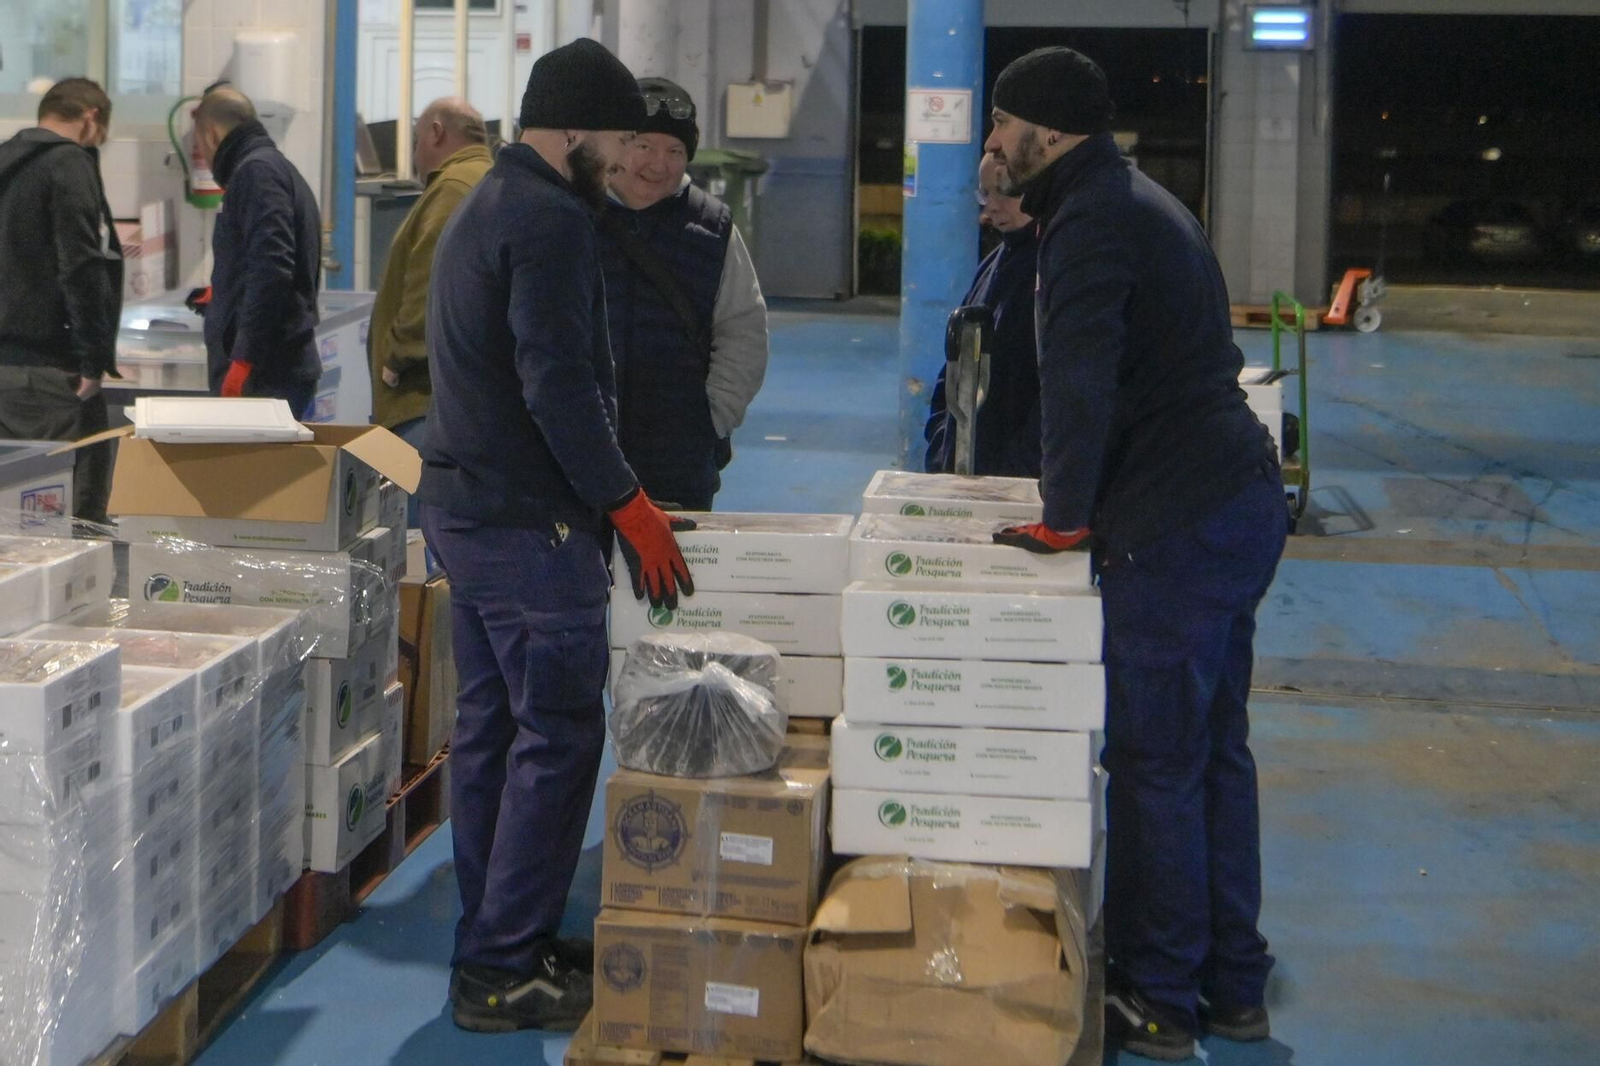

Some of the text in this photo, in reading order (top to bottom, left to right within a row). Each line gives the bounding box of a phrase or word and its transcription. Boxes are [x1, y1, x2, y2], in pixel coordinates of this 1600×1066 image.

[928, 507, 973, 518] Tradición
[679, 544, 719, 554] radición
[685, 556, 718, 566] squera
[916, 555, 963, 567] Tradición
[915, 566, 962, 579] Pesquera
[183, 580, 232, 593] Tradición
[183, 592, 231, 604] Pesquera
[676, 606, 723, 617] Tradición
[919, 604, 970, 616] Tradición
[677, 617, 722, 630] Pesquera
[920, 615, 970, 629] Pesquera
[911, 668, 962, 681] Tradición
[911, 680, 961, 694] Pesquera
[906, 738, 957, 750] Tradición
[906, 749, 956, 763] Pesquera
[910, 805, 961, 817] Tradición
[910, 817, 960, 831] Pesquera
